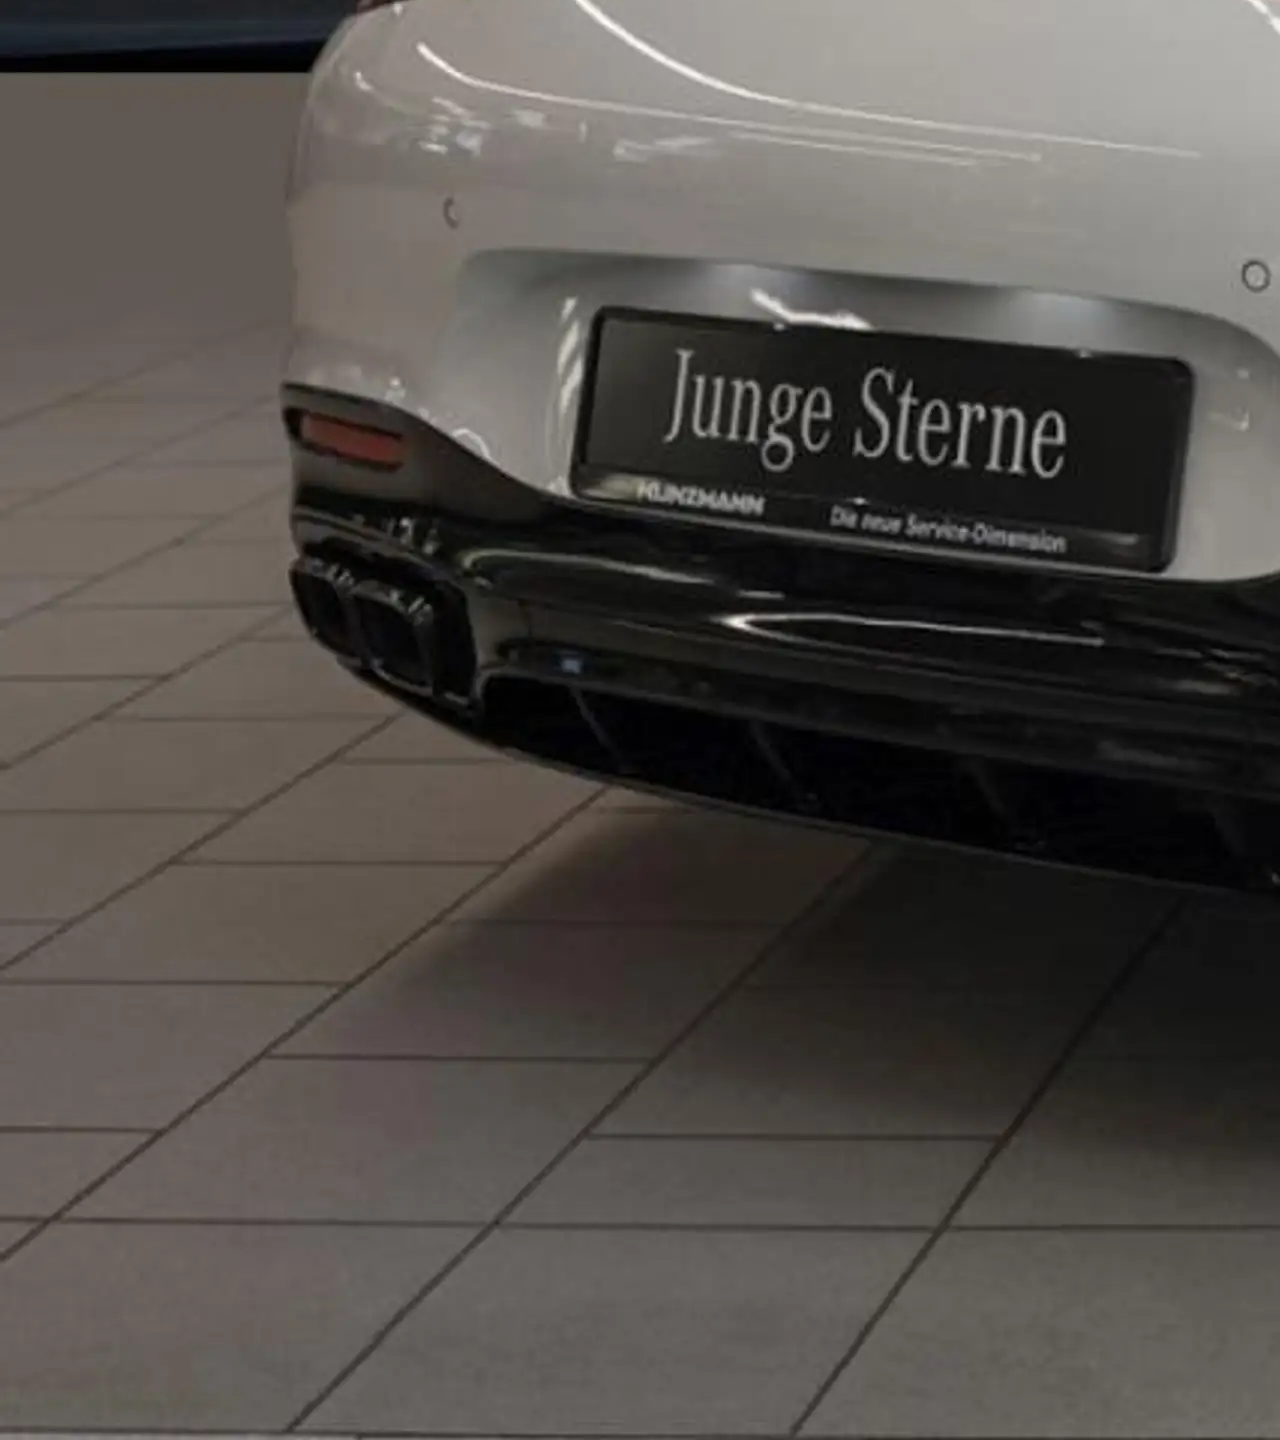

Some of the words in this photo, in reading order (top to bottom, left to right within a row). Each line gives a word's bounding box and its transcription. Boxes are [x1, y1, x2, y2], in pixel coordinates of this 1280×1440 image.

[663, 348, 833, 472] Junge
[852, 366, 1067, 479] Sterne
[637, 478, 766, 516] KUNZMANN
[830, 503, 858, 530] Die
